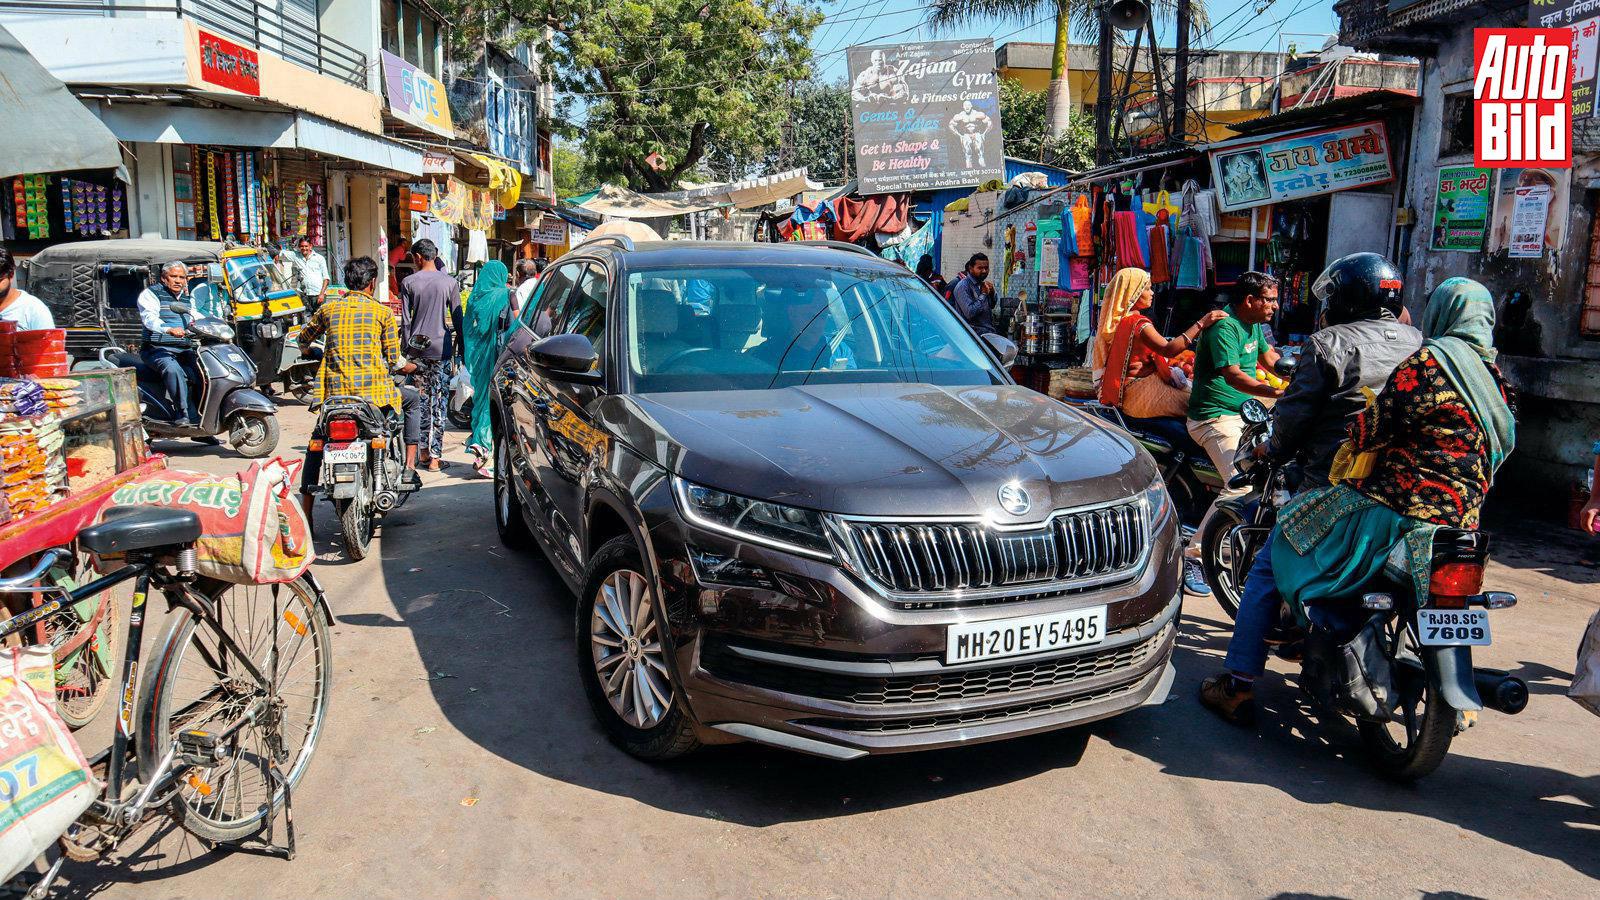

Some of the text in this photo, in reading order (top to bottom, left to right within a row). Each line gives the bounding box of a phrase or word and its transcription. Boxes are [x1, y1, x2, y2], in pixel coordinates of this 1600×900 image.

[896, 58, 957, 79] Zajam
[952, 70, 993, 90] Gym
[911, 90, 992, 104] & Fitness Center
[859, 107, 915, 124] Gents &
[860, 139, 940, 156] Get in Shape &
[1267, 128, 1384, 173] जय अम्बे
[872, 156, 931, 172] Be Healthy
[876, 182, 902, 192] Special
[904, 181, 929, 189] Thanks
[935, 179, 960, 187] Andhra
[961, 177, 980, 185] Bank
[1272, 172, 1330, 193] स्टोर
[1426, 627, 1484, 640] 7609
